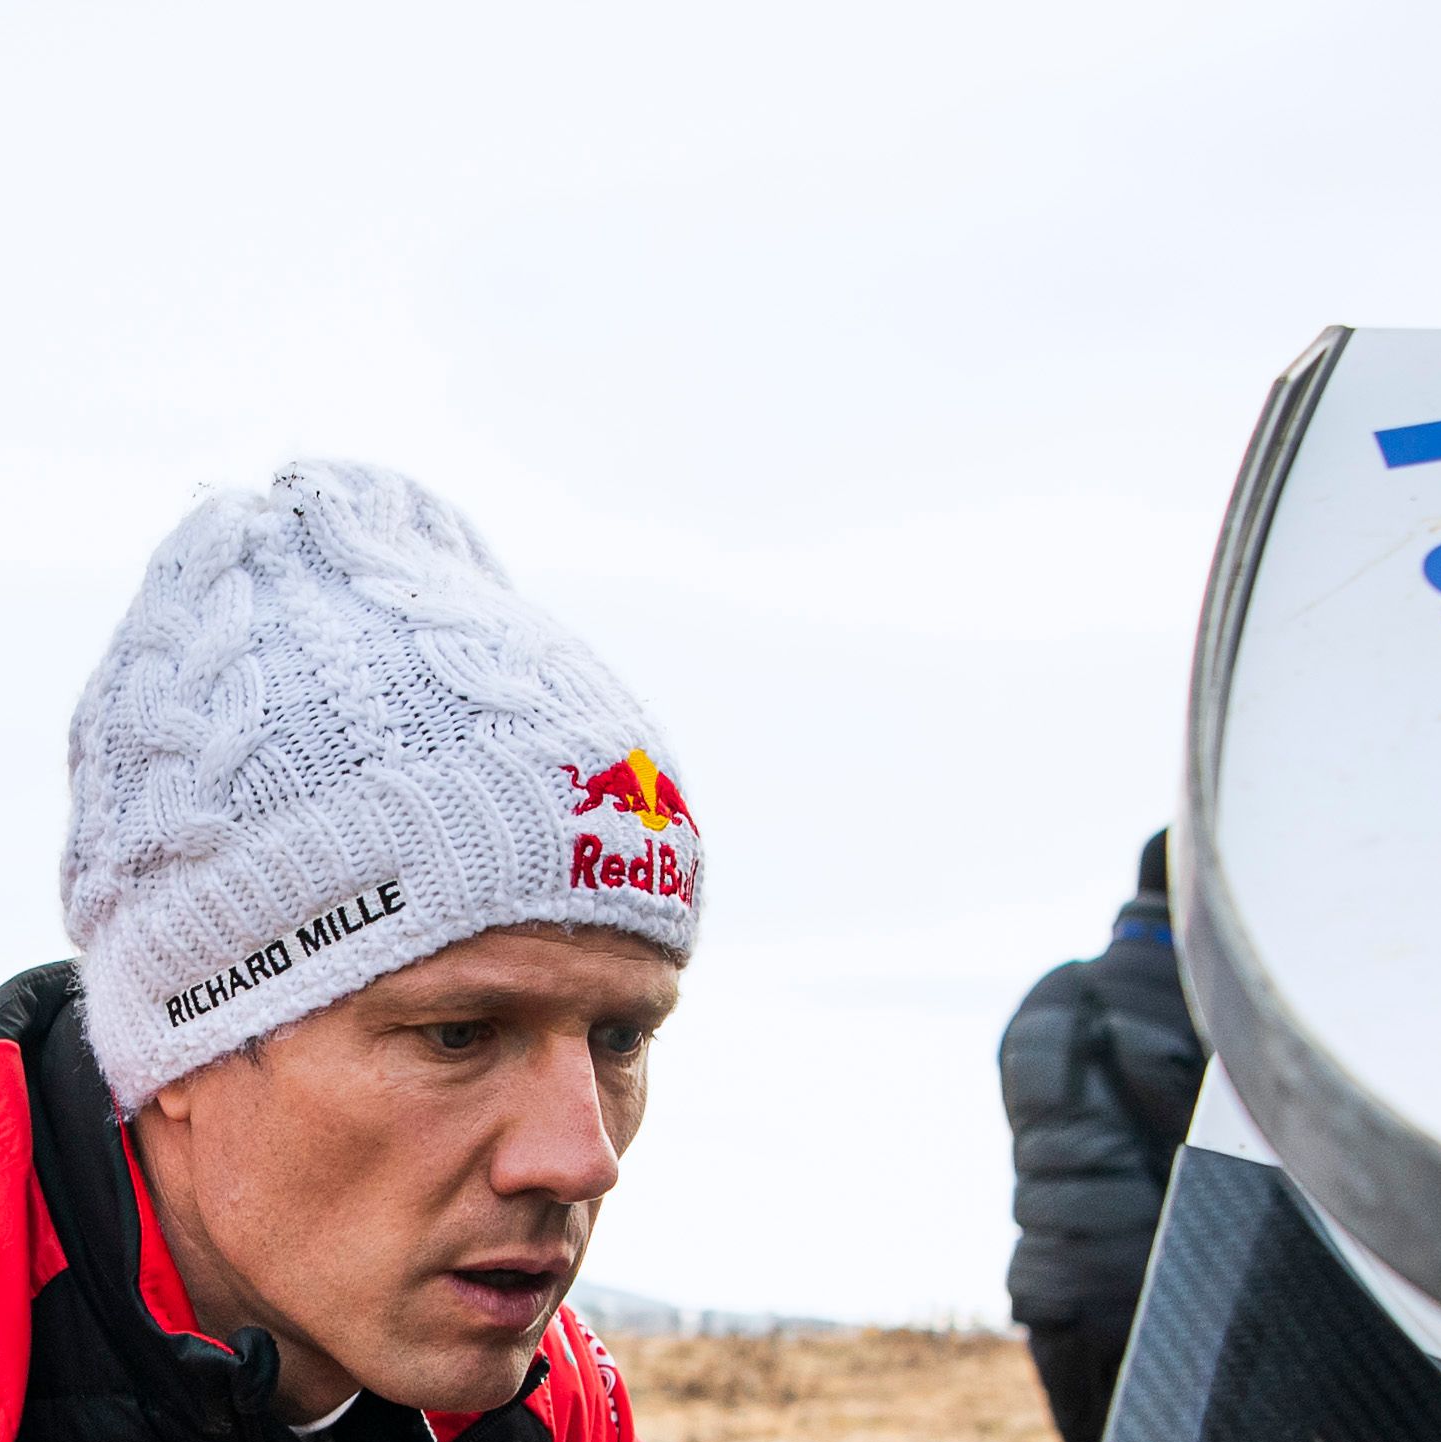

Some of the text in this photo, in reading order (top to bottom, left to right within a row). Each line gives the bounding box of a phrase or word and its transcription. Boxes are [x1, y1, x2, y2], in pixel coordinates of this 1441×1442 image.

[569, 832, 655, 896] Red
[166, 880, 407, 1028] RICHARD MILLE
